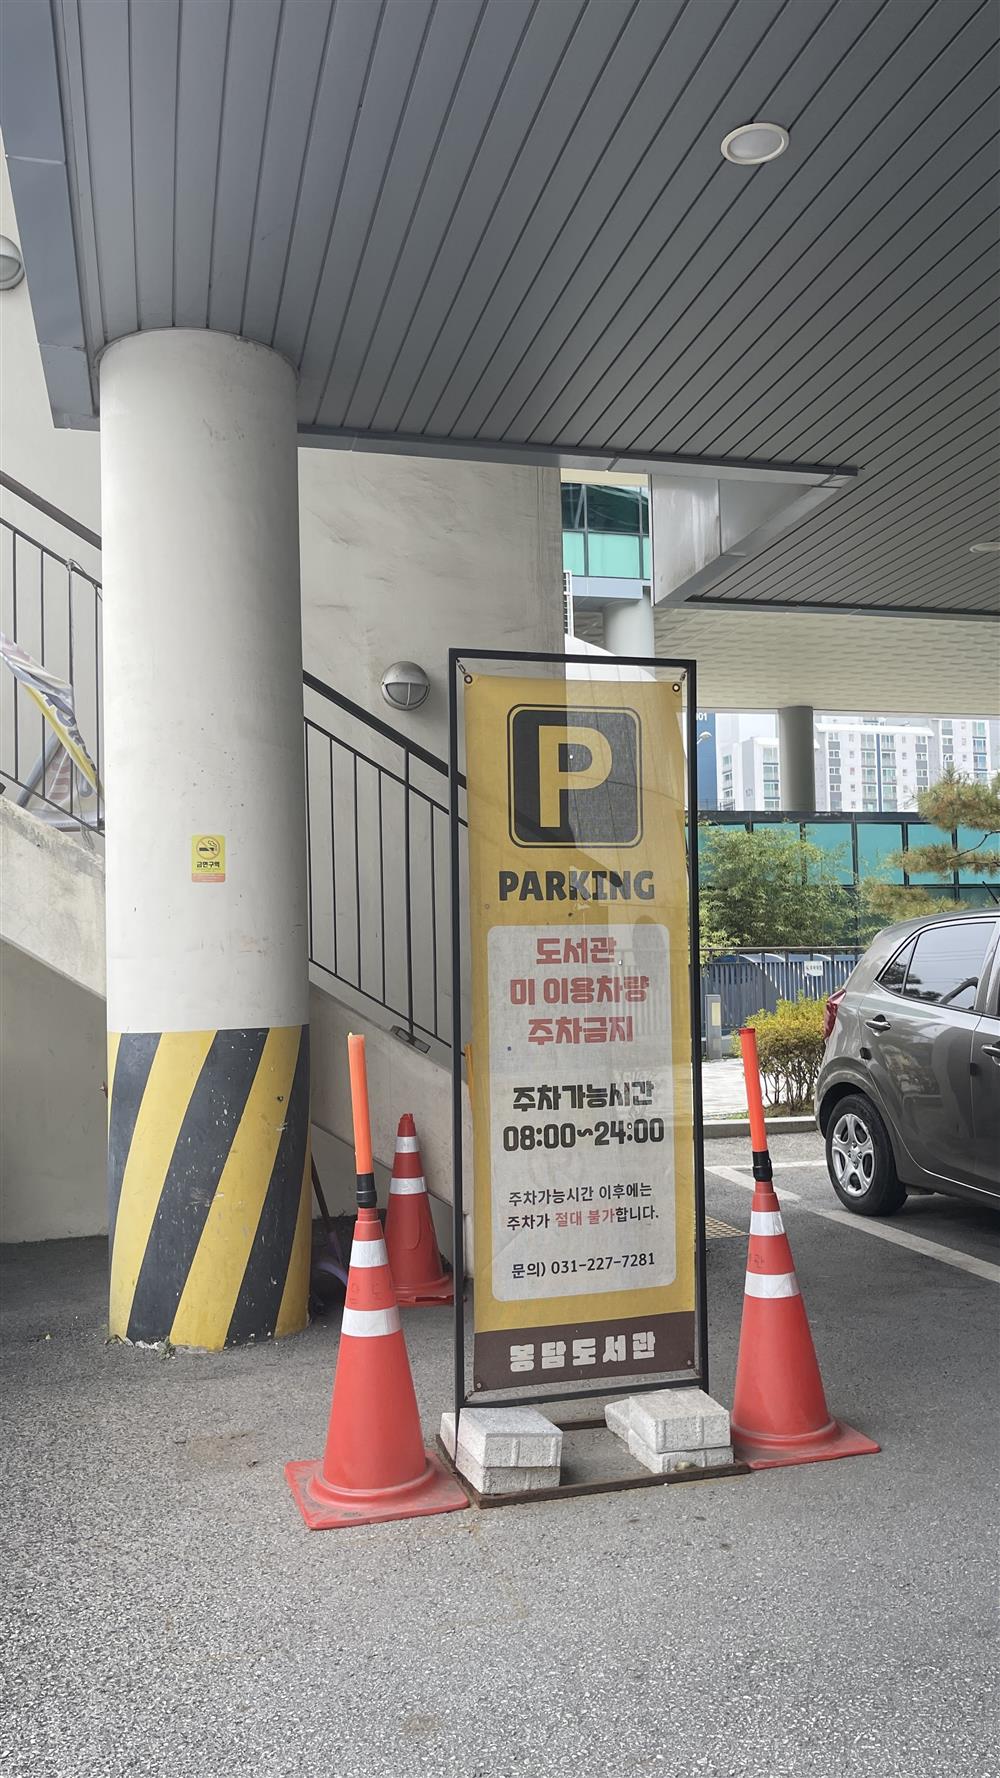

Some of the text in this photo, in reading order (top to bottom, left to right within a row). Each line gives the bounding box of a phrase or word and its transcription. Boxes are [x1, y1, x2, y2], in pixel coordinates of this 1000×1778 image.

[538, 725, 612, 828] P
[498, 870, 655, 902] PARKING
[536, 936, 617, 965] 도서관
[510, 975, 650, 1006] 미 이용차량
[527, 1016, 634, 1046] 주차금지
[512, 1080, 655, 1113] 주차가능시간
[502, 1117, 665, 1152] 08:00~24:00
[508, 1182, 653, 1206] 주차가능시간 이후에는
[506, 1205, 660, 1231] 주차가 절대 불가합니다.
[511, 1252, 656, 1279] 문의) 031-227-7281
[509, 1331, 656, 1372] 봉담도서관
